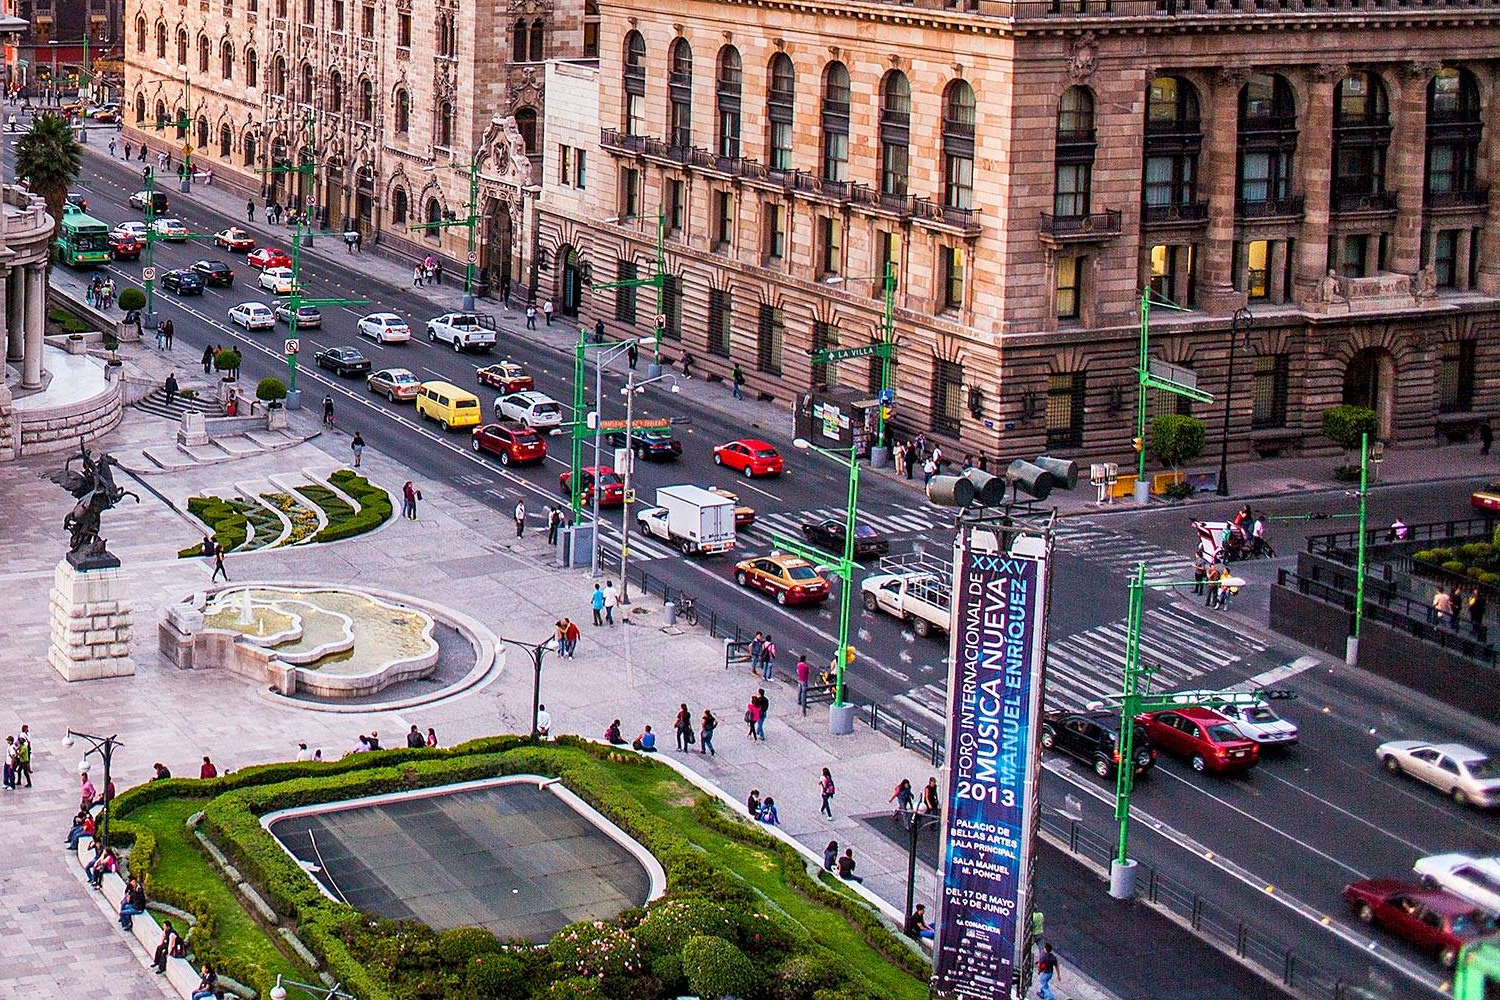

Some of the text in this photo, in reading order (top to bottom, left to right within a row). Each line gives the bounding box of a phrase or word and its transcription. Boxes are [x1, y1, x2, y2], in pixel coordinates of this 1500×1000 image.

[838, 347, 874, 358] LA VILLA
[970, 555, 1027, 575] XXXV
[958, 572, 983, 778] FORO INTERNACIONAL DE
[974, 577, 1007, 782] MÚSICA NUEVA
[1000, 578, 1027, 787] MANUEL ENRÍQUEZ
[957, 781, 1015, 807] 2013
[950, 828, 1017, 849] BELLAS ARTES
[956, 819, 1010, 837] PALACIO DE
[951, 839, 1016, 859] SALA PRINCIPAL
[952, 857, 1010, 875] SALA MANUEL
[961, 866, 1001, 882] M. PONCE
[945, 887, 1015, 909] DEL 17 DE MAYO
[950, 896, 1010, 917] AL 9 DE JUNIO
